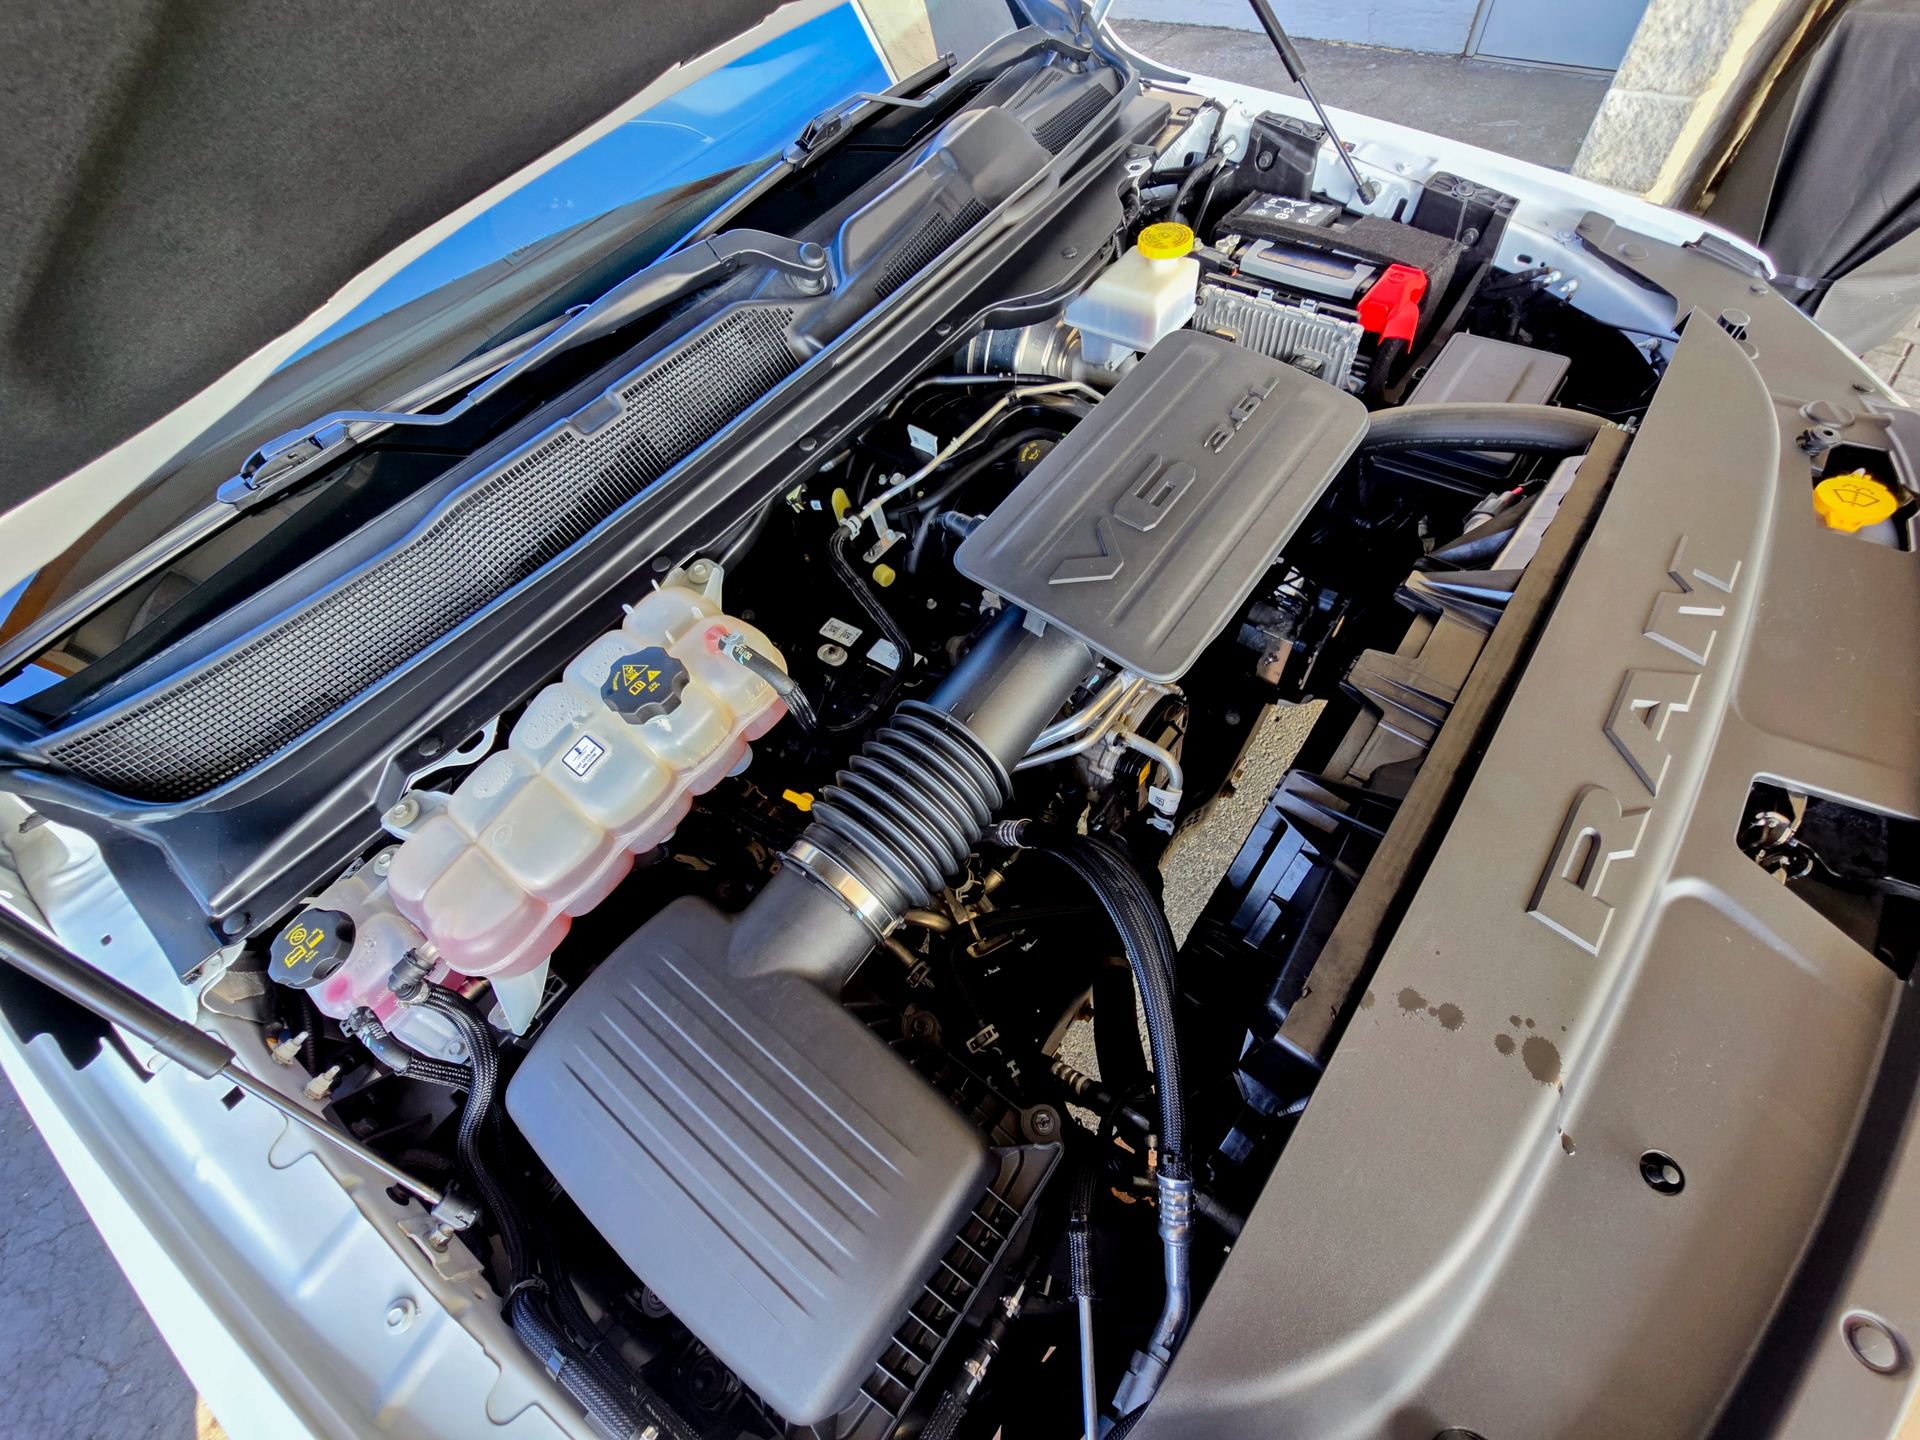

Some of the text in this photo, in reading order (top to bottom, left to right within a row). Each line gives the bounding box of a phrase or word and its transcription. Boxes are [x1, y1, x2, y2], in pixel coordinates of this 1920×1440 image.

[1048, 377, 1280, 585] V6 3.6L
[1526, 534, 1742, 957] RAM
